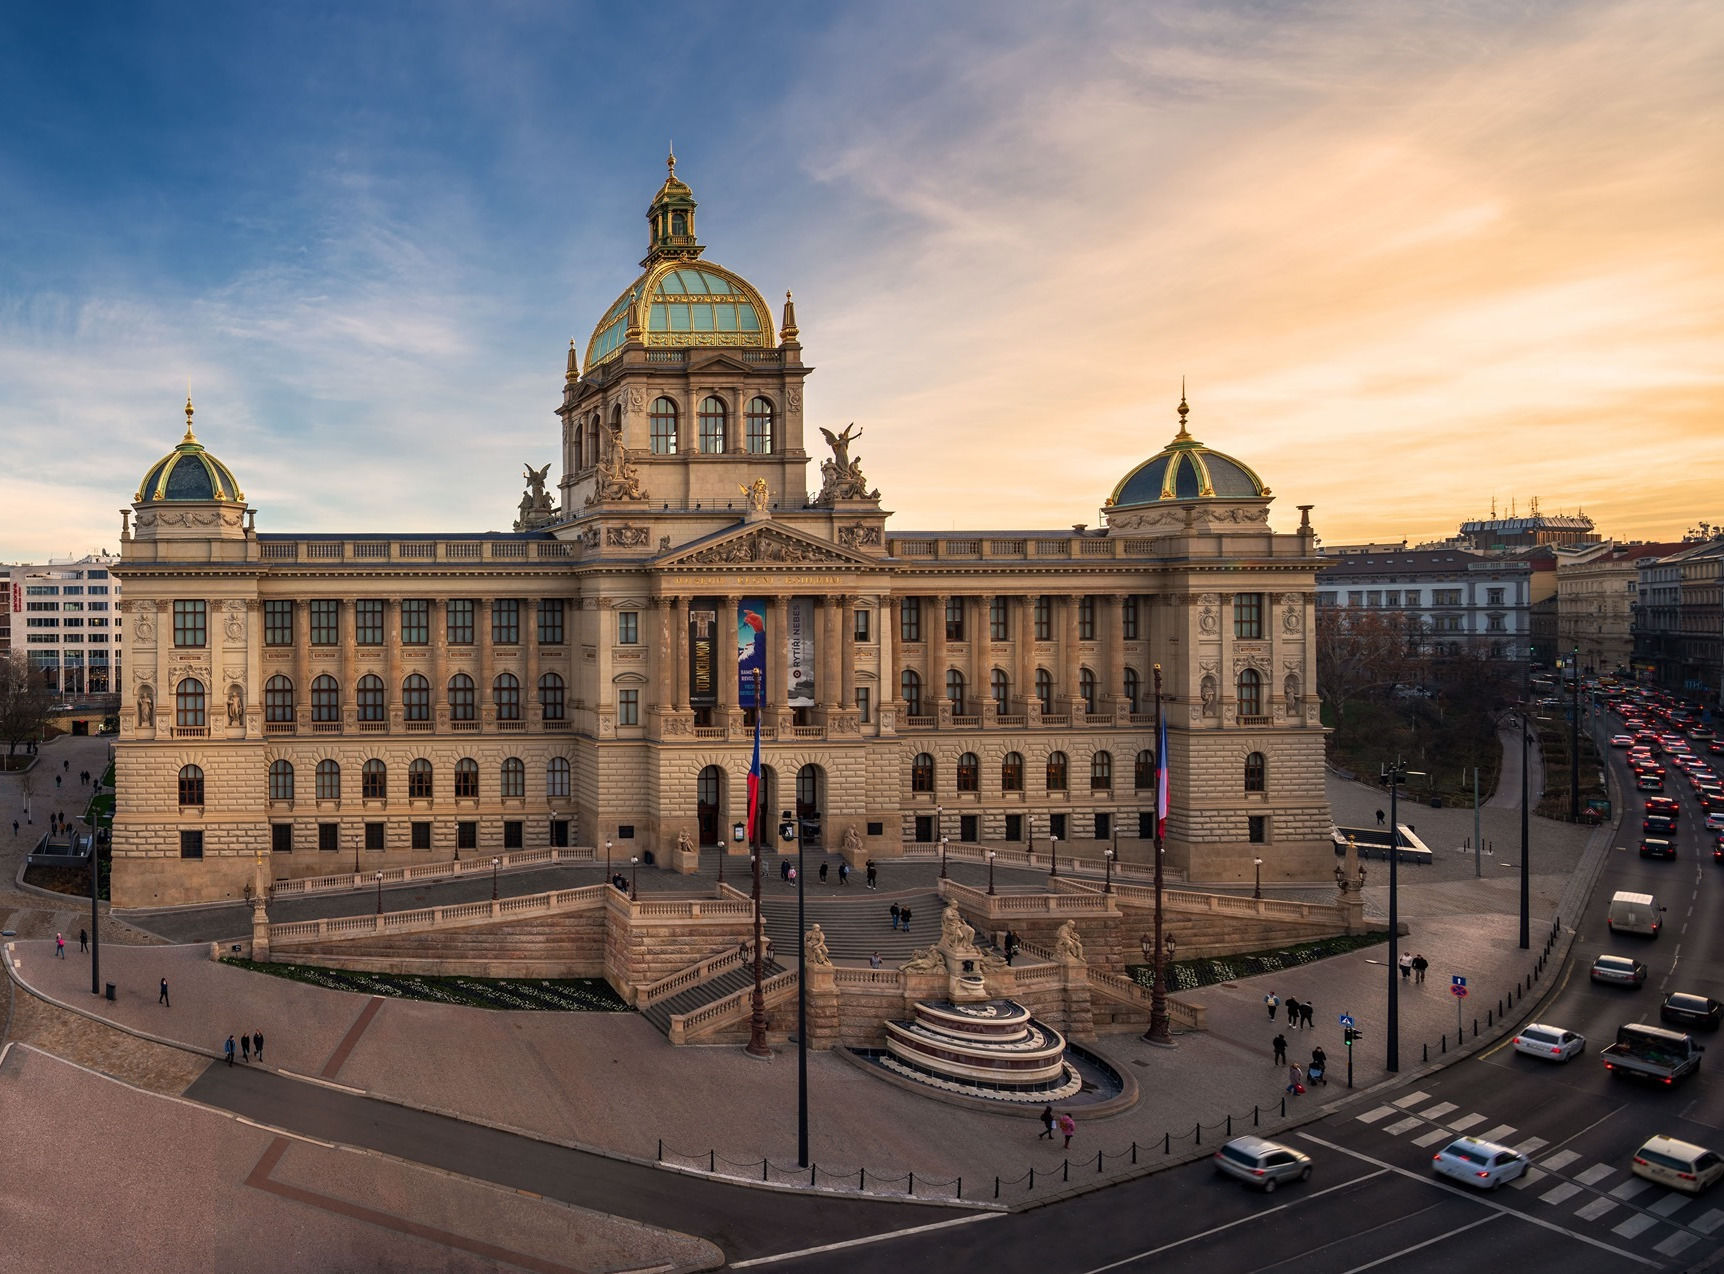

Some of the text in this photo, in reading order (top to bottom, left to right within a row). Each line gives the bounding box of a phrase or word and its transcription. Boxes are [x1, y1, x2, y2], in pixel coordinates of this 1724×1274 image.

[792, 605, 801, 668] RYTÍŘI NEBES
[695, 641, 710, 692] TUTANCHAMON
